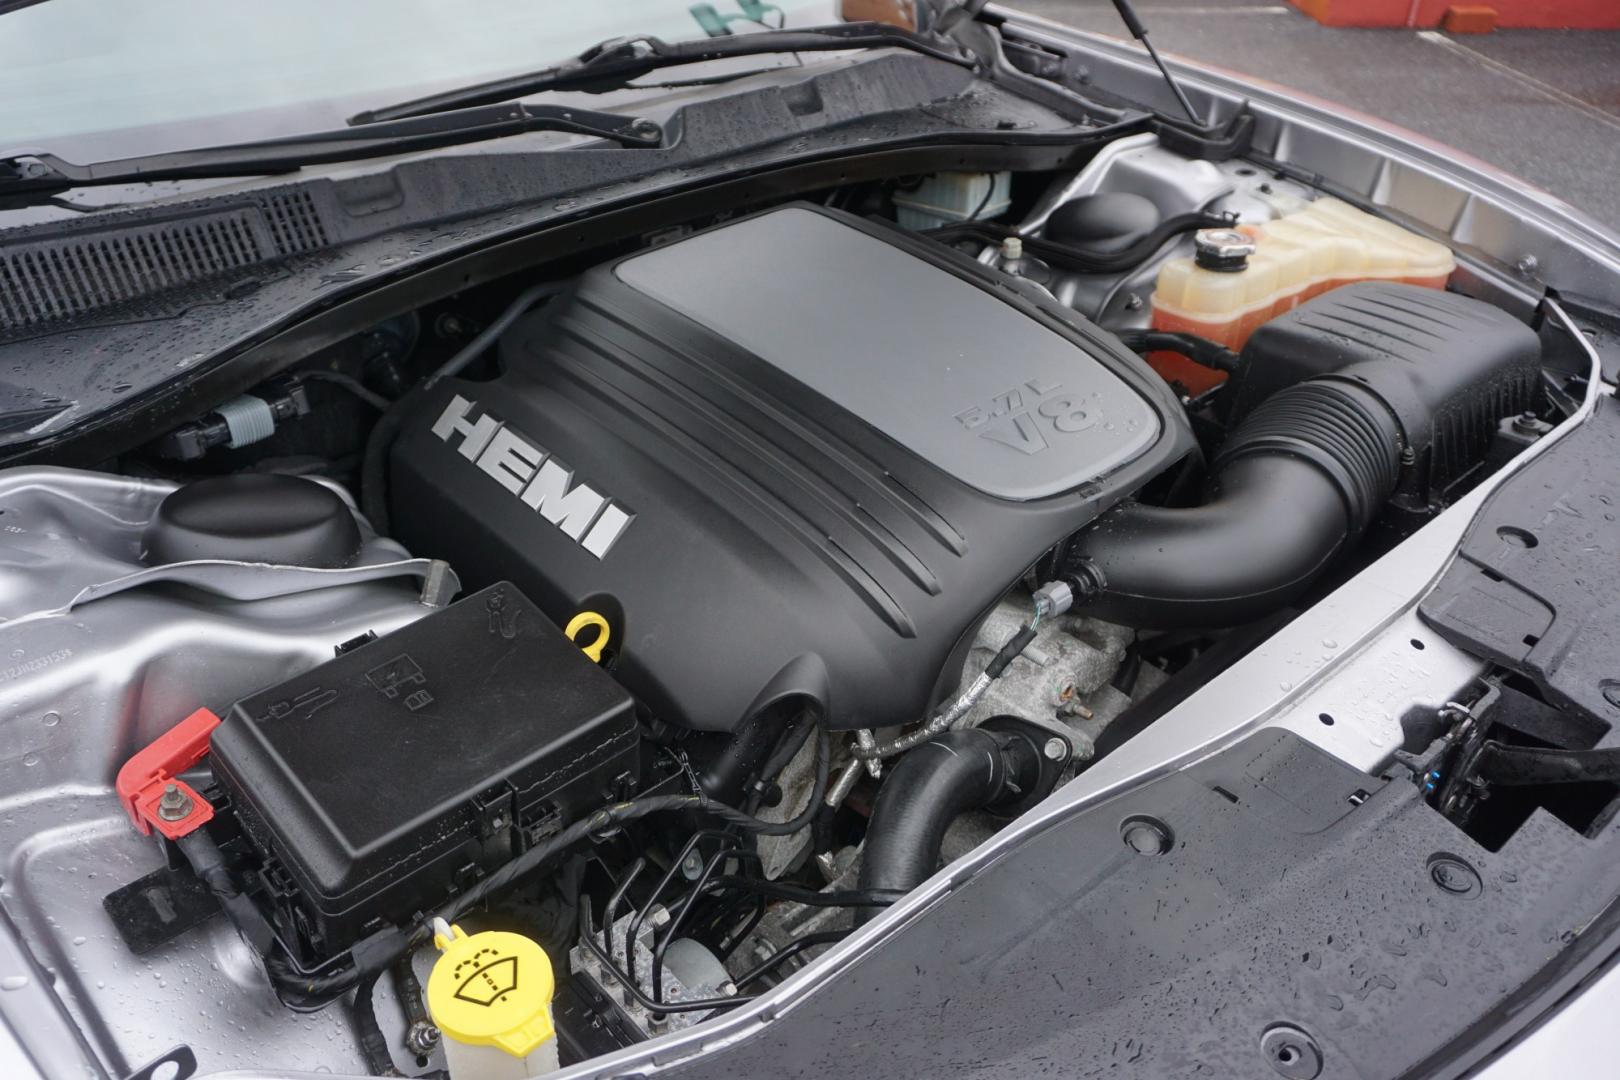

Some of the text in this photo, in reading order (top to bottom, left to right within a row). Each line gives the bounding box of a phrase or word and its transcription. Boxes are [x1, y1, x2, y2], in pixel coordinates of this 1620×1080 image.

[952, 378, 1062, 429] 5.7L
[978, 394, 1103, 456] V8
[431, 394, 637, 560] HEMI
